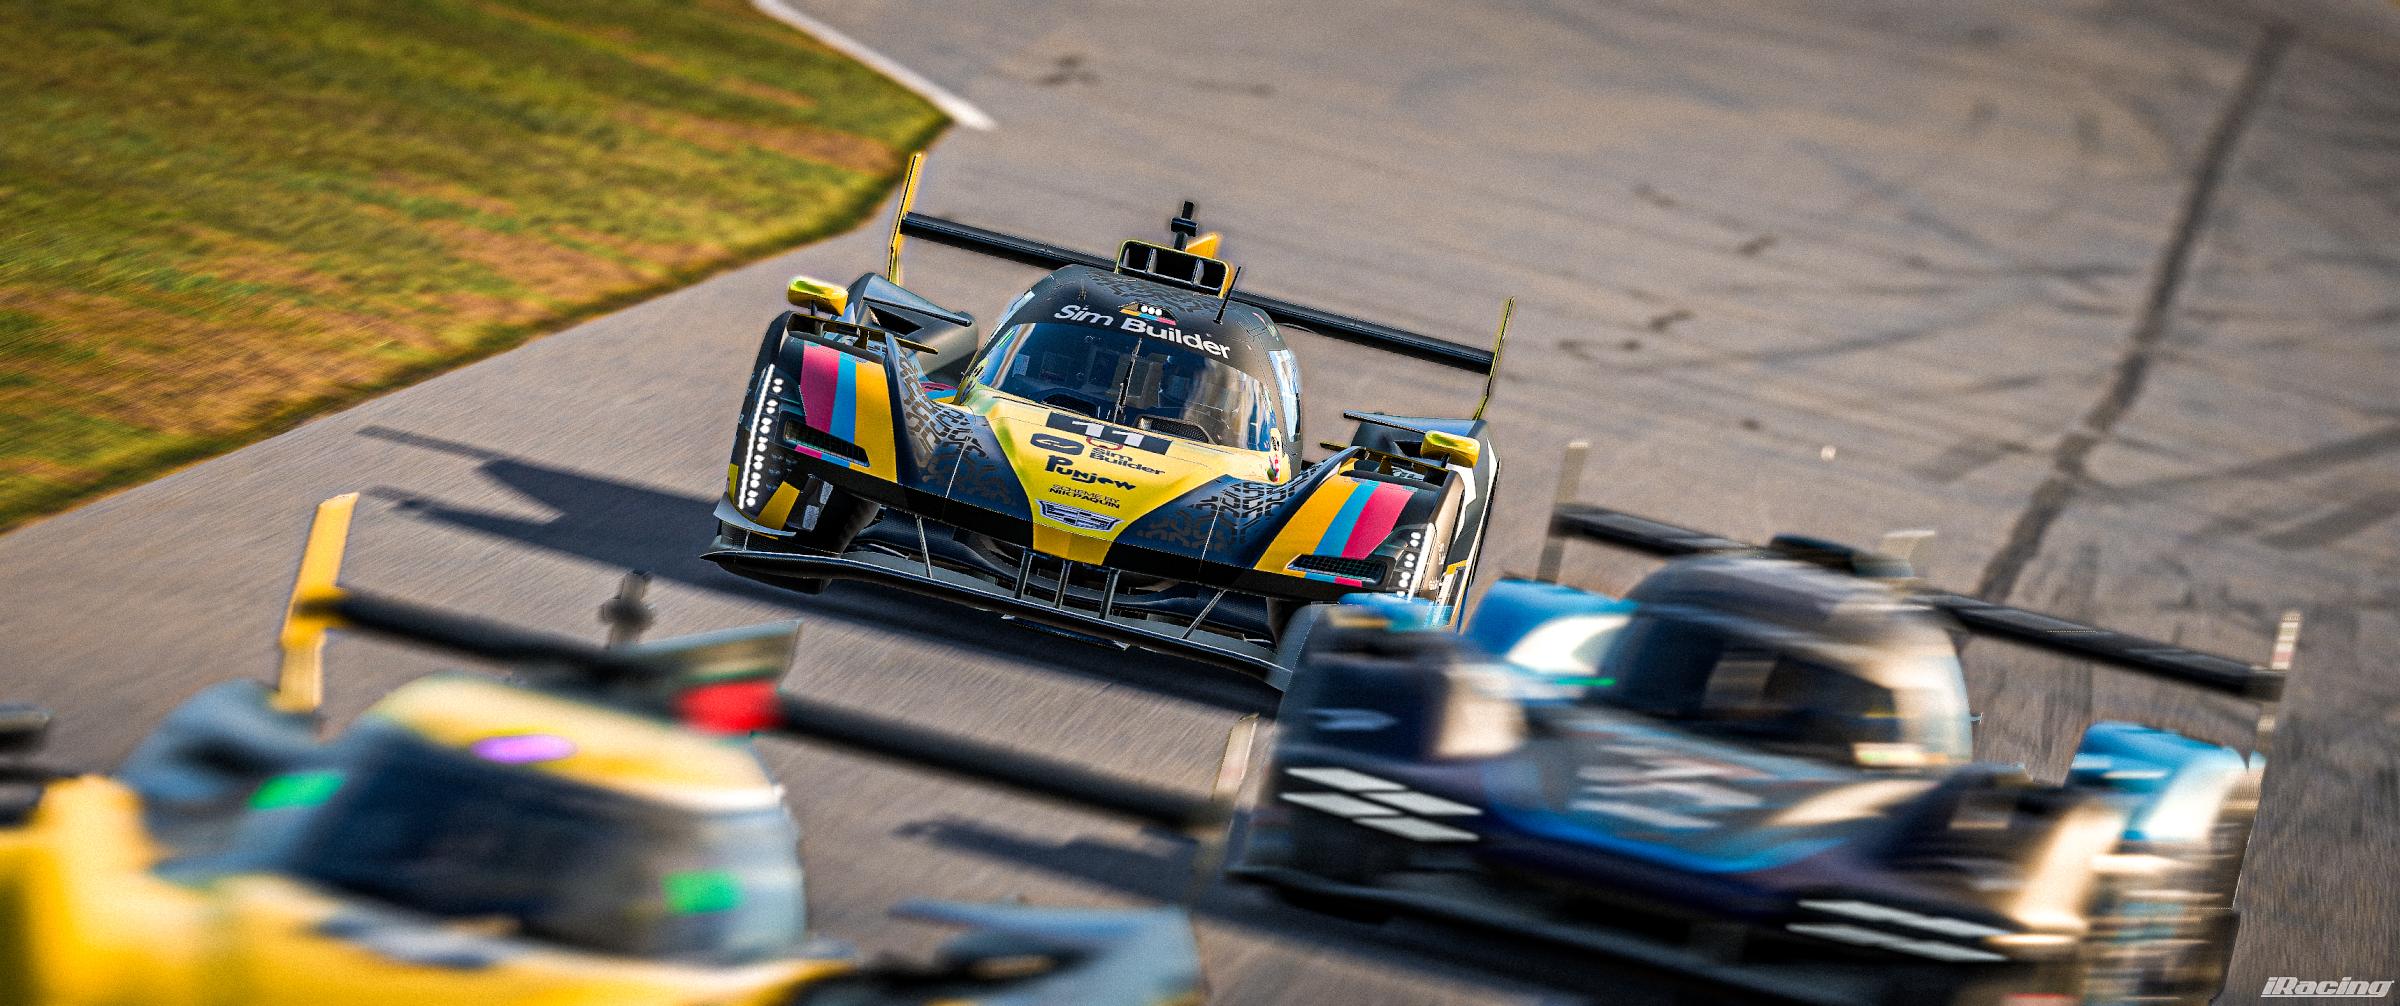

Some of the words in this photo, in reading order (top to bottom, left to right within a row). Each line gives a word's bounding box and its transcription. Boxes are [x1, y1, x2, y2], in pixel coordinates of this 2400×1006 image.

[1054, 304, 1114, 326] Sim
[1120, 317, 1231, 359] Builder
[1072, 420, 1145, 447] 11
[1089, 452, 1166, 475] Builder
[1091, 447, 1133, 462] Sim
